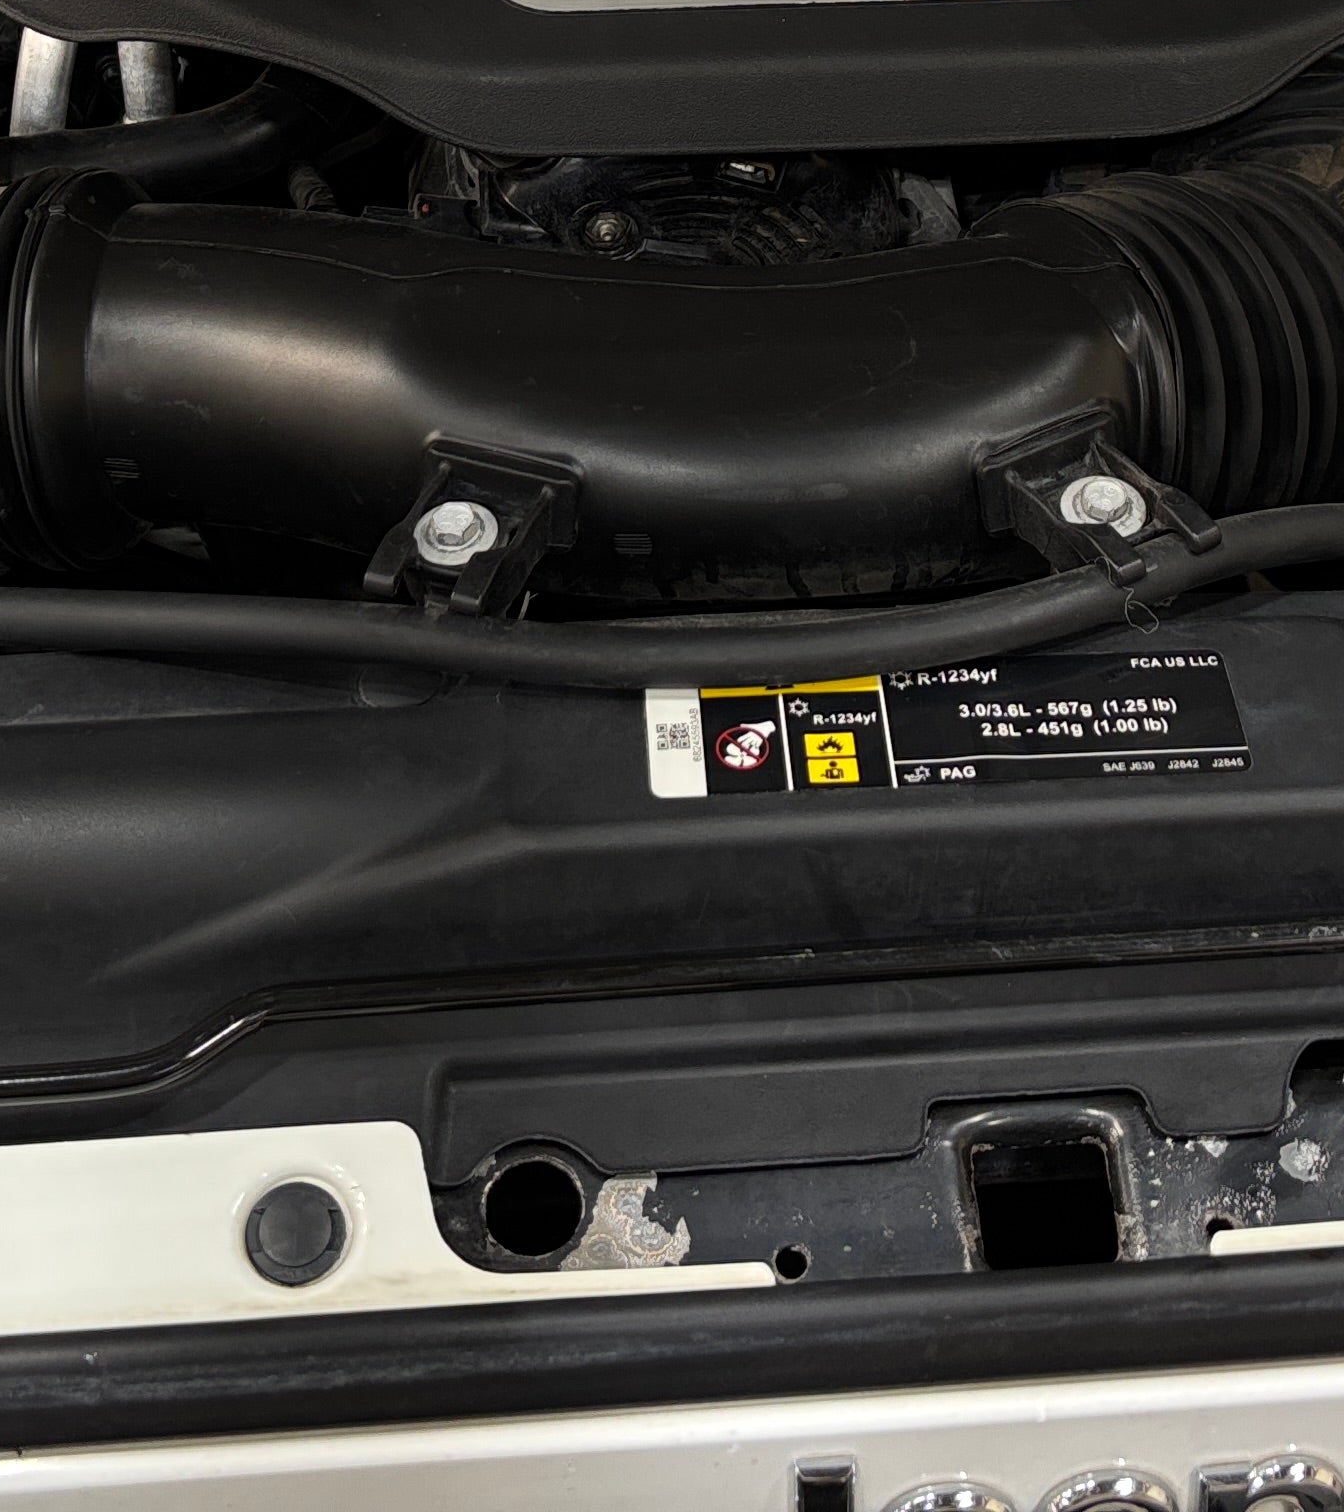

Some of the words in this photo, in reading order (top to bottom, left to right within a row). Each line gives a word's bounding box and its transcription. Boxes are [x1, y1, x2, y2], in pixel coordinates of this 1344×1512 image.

[1130, 657, 1162, 669] FCA
[1165, 656, 1186, 668] US
[1189, 655, 1219, 667] LLC
[917, 668, 998, 686] R-1234yf
[958, 703, 1031, 718] 3.0/3.6L
[1047, 701, 1093, 717] 567g
[1102, 699, 1148, 717] (1.25
[1152, 697, 1178, 714] lb)
[813, 711, 877, 727] R-1234yf
[981, 722, 1022, 737] 2.8L
[1037, 721, 1083, 737] 451g
[1093, 719, 1139, 737] (1.00
[1143, 717, 1169, 734] lb)
[940, 765, 977, 780] PAG
[1102, 762, 1127, 772] SAE
[1129, 760, 1156, 772] J639
[1167, 759, 1200, 770] J2842
